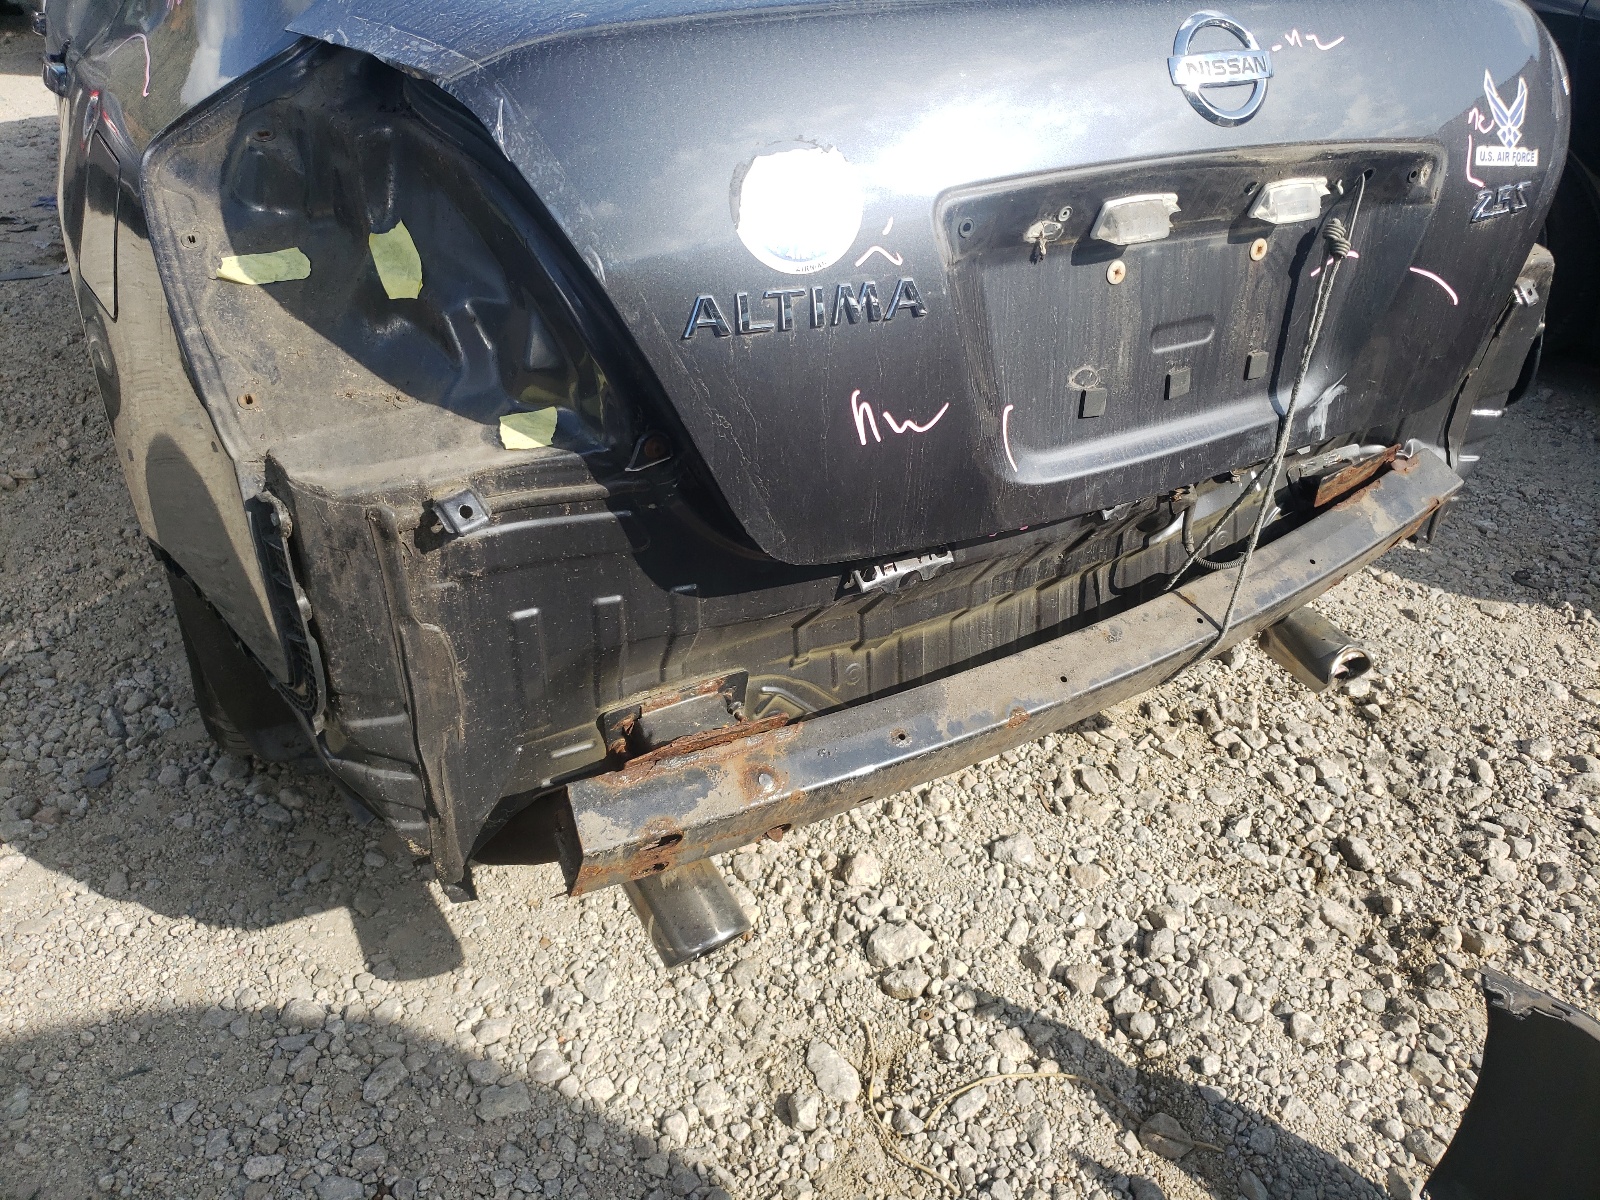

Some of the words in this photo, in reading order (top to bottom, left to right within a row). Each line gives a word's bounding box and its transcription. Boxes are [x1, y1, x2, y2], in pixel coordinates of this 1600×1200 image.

[1186, 55, 1267, 76] NISSAN
[1479, 151, 1495, 162] U.S.
[1496, 151, 1511, 162] AIR
[1511, 151, 1536, 163] FORCE
[681, 277, 928, 340] ALTIMA
